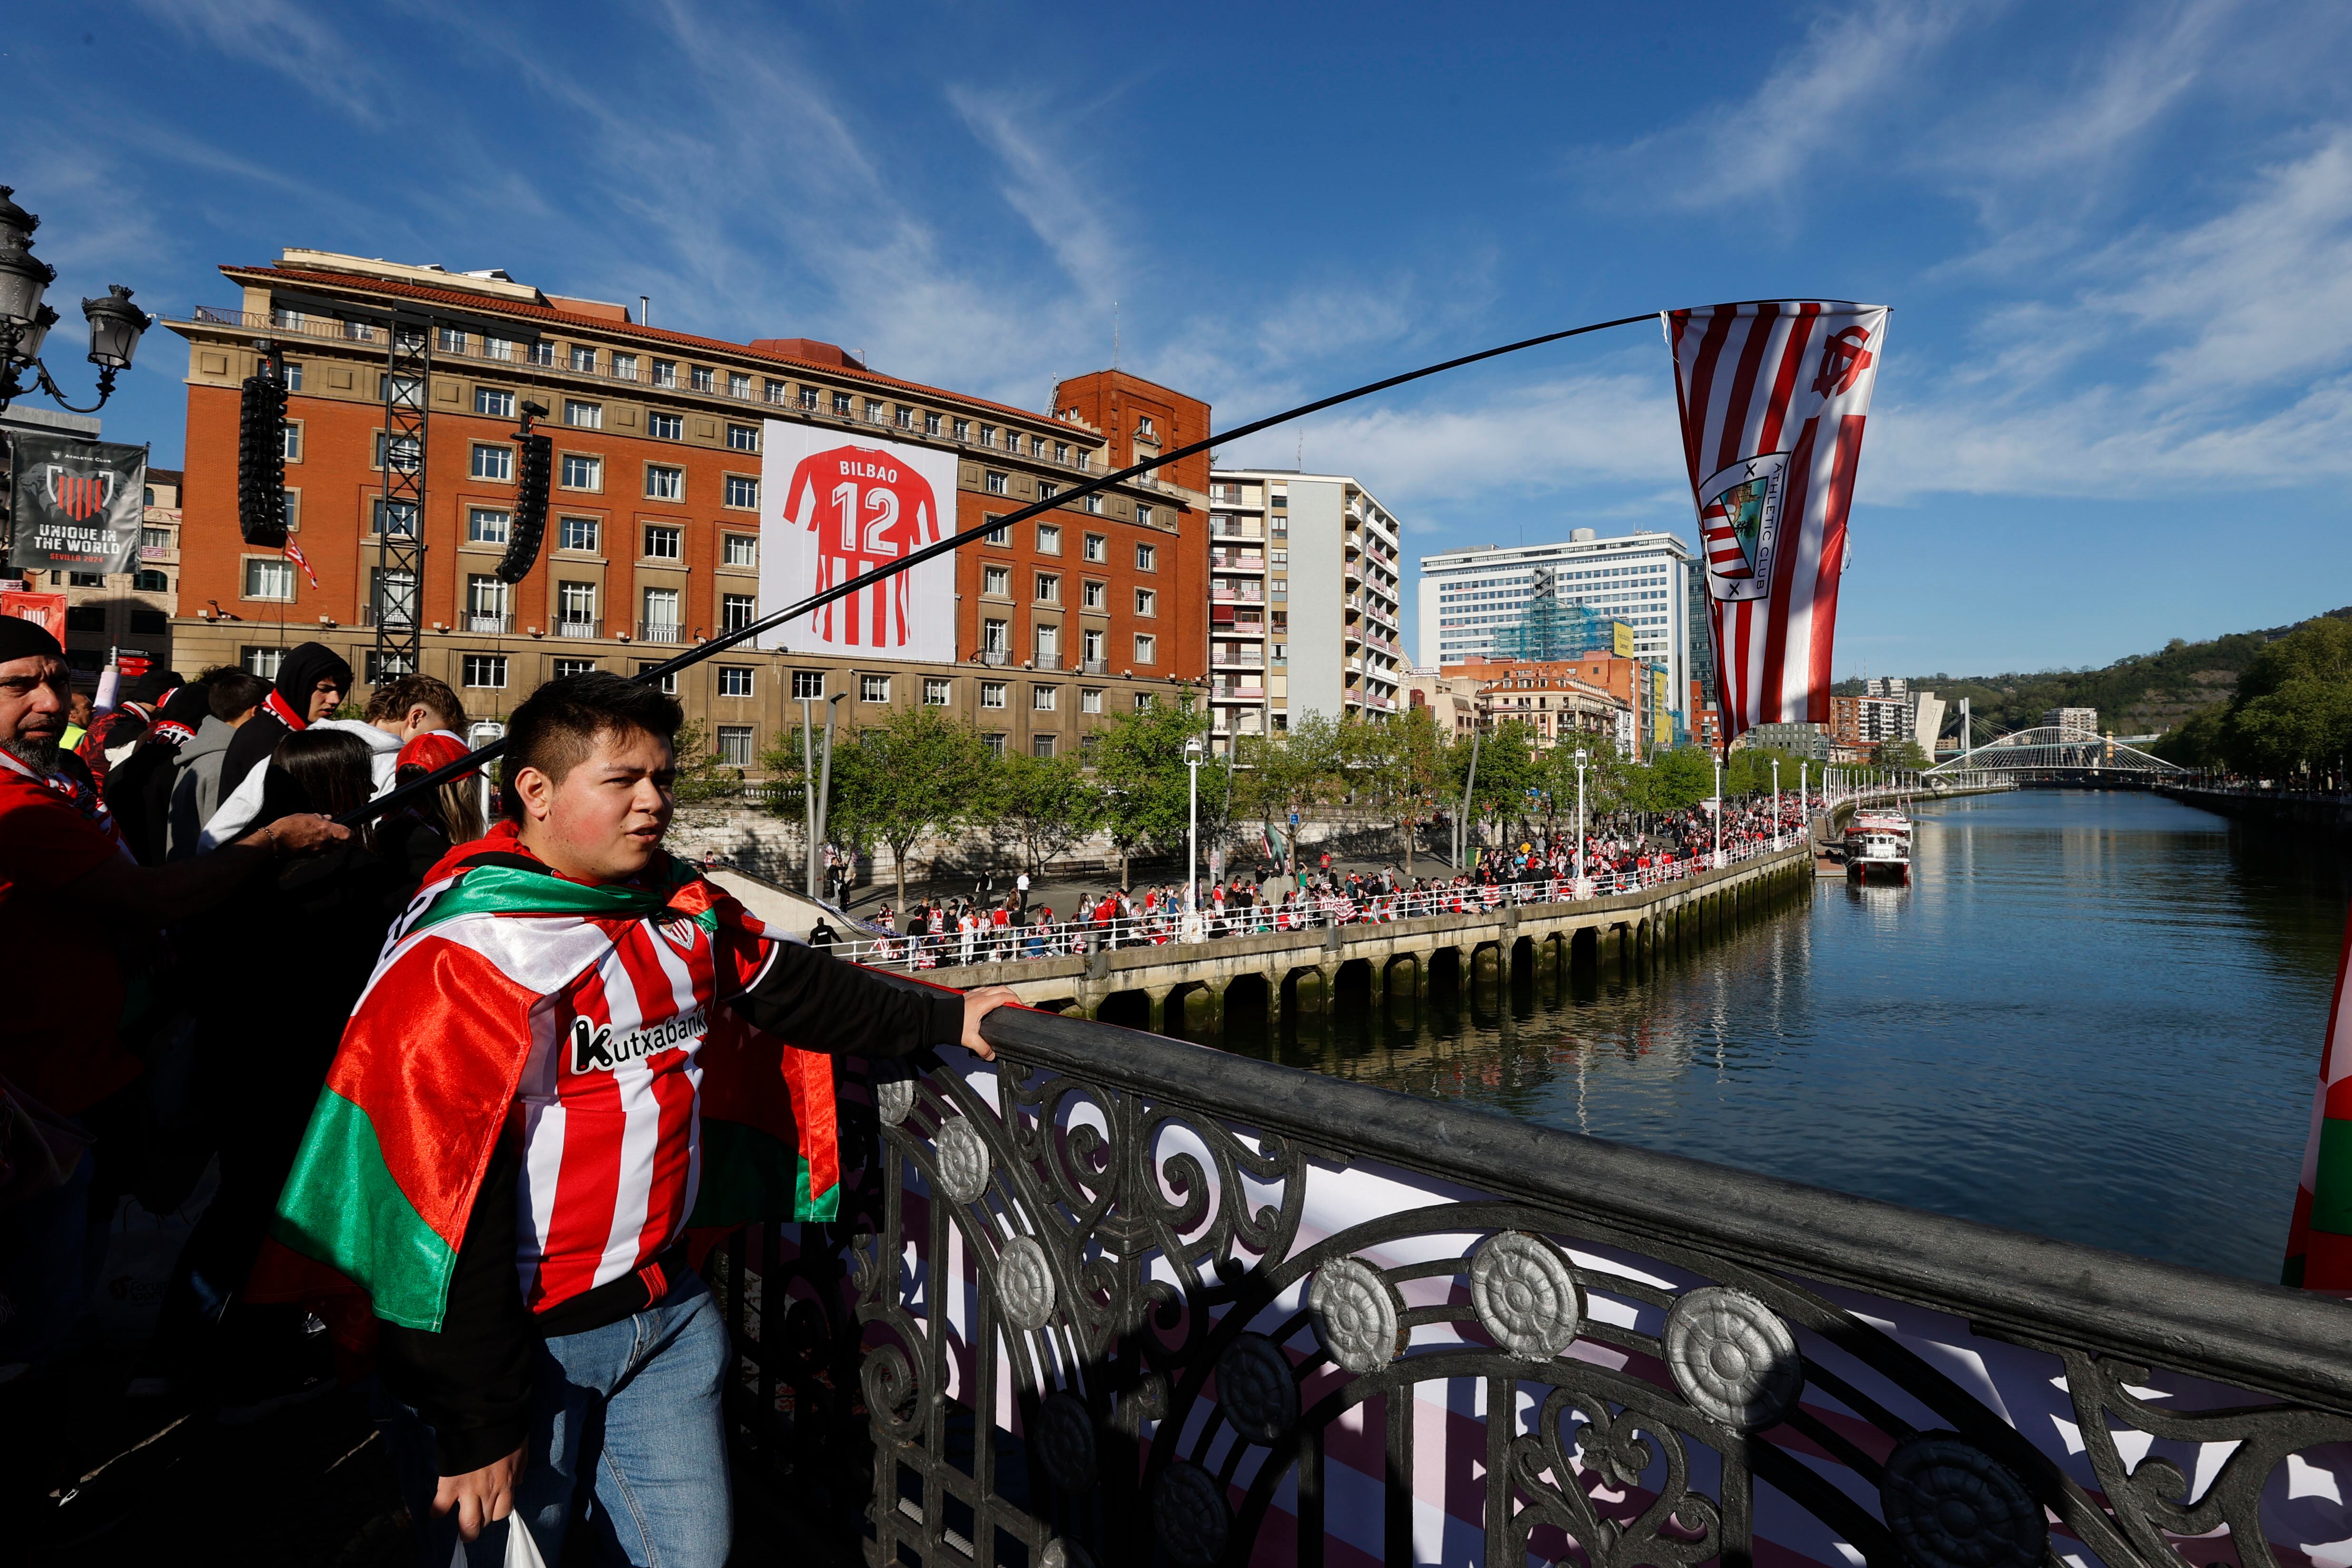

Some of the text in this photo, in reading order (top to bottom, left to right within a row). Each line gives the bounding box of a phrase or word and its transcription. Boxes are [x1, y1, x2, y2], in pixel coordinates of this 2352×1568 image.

[839, 460, 897, 484] BILBAO
[831, 481, 900, 557] 12
[1756, 462, 1782, 590] ATHLETIC CLUB
[34, 536, 121, 554] THE WORLD
[39, 524, 117, 542] UNIQUE IN
[50, 553, 81, 562] SEVILLA
[575, 1008, 707, 1072] Kutxabank
